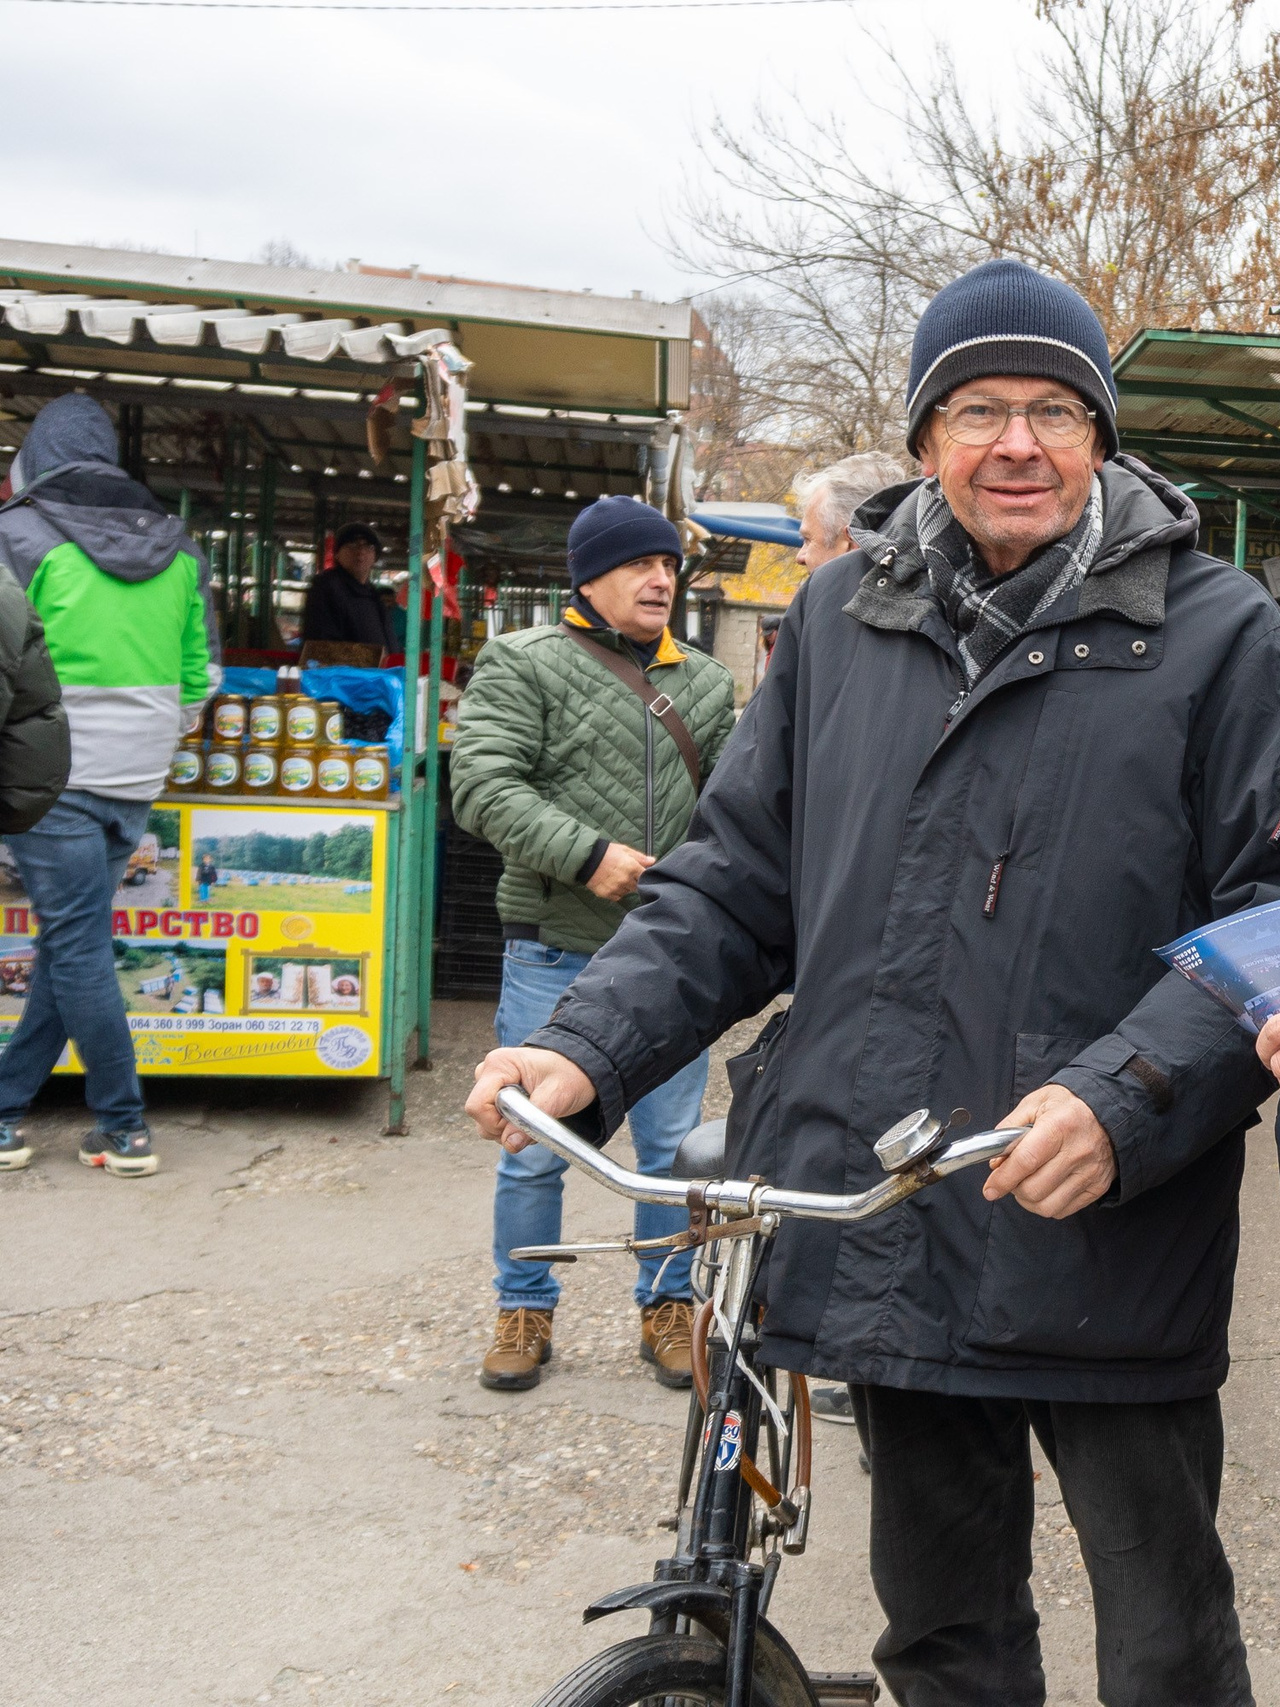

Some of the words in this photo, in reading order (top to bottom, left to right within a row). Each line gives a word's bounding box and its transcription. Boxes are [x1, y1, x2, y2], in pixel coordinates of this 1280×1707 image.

[990, 863, 1000, 884] Wind
[985, 894, 994, 912] Wear
[4, 906, 260, 939] ПАРСТВО
[130, 1020, 150, 1029] 064
[153, 1020, 172, 1030] 360
[175, 1021, 182, 1030] 8
[186, 1021, 205, 1030] 999
[209, 1021, 242, 1033] Зоран
[246, 1021, 265, 1031] 060
[268, 1021, 286, 1031] 521
[290, 1021, 303, 1031] 22
[306, 1021, 319, 1032] 78
